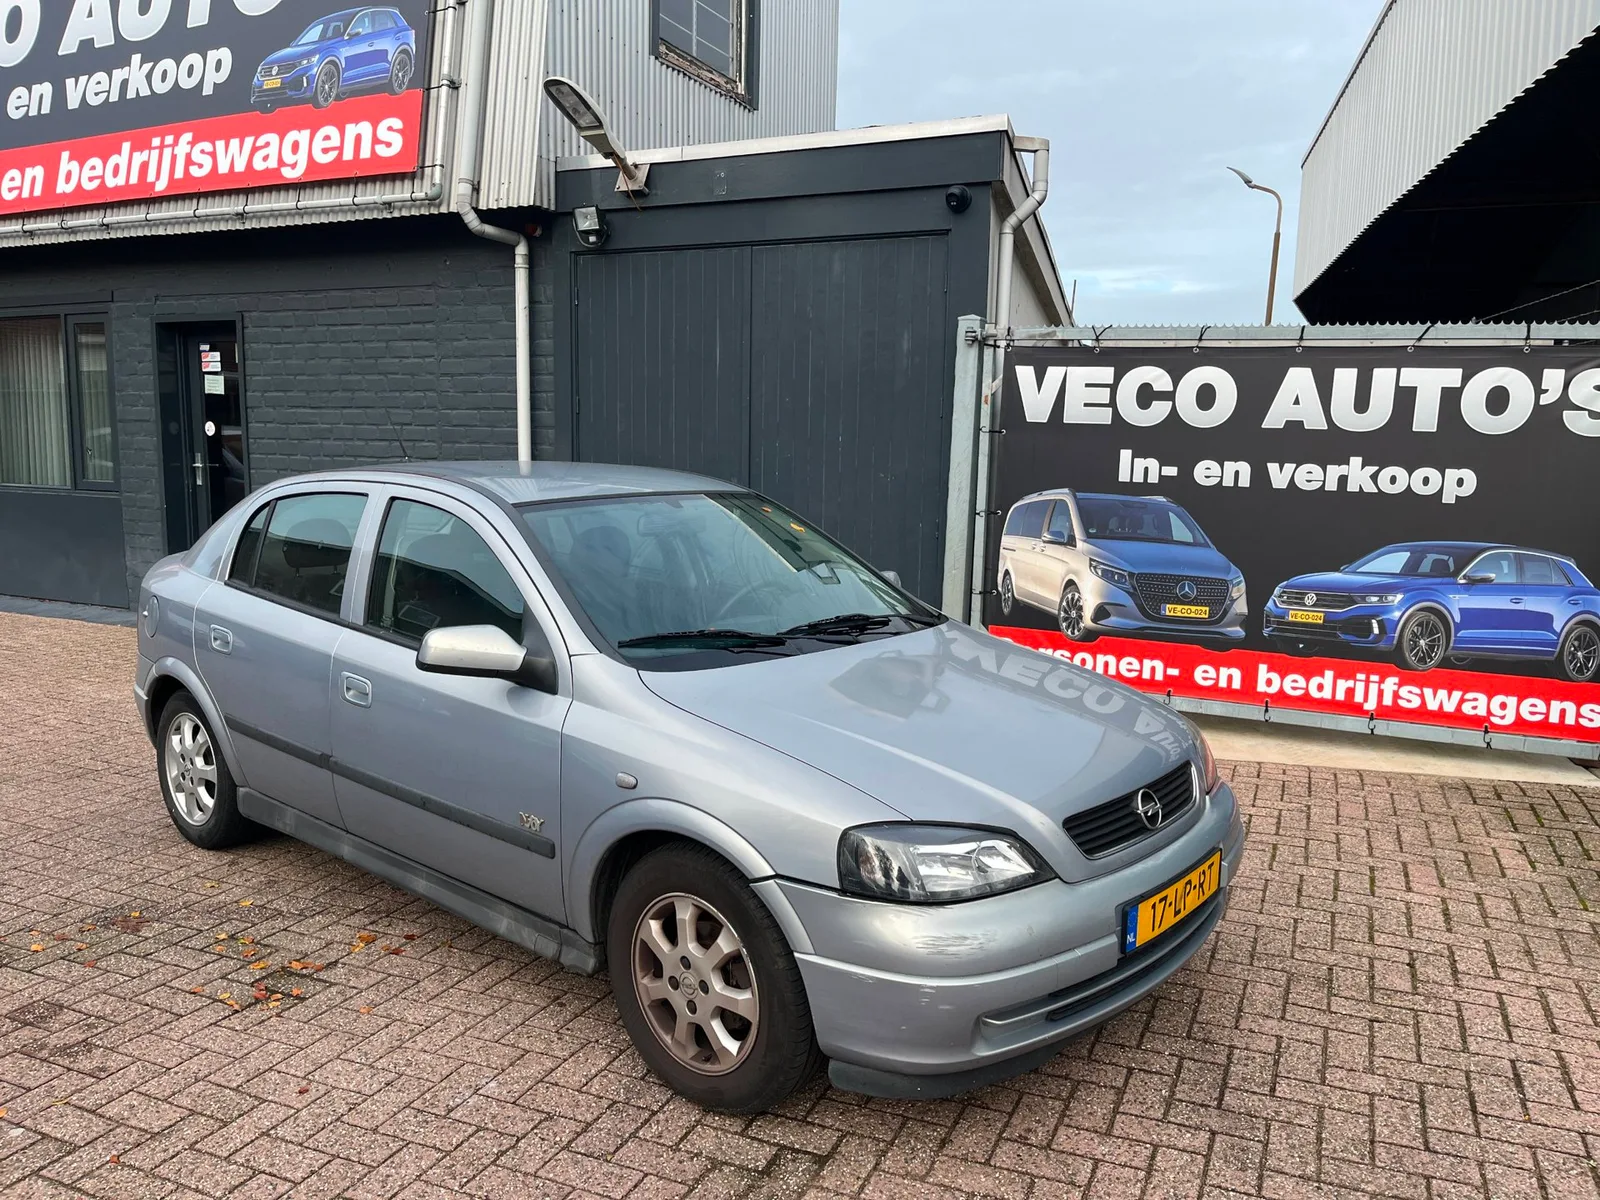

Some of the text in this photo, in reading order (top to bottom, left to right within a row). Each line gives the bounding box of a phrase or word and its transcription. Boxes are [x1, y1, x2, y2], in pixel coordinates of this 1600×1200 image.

[7, 47, 233, 120] en verkoop
[1, 116, 404, 201] en bedrijfswagens
[1014, 364, 1600, 437] VECO AUTO'S
[1118, 448, 1479, 504] In- en verkoop
[1167, 606, 1208, 616] VE-CO-024
[1290, 612, 1323, 622] VE-CO-024
[1193, 663, 1242, 690] en
[1256, 664, 1600, 727] bedrijfswagens
[1150, 861, 1217, 932] 17-LP-RT
[1126, 931, 1136, 945] NL
